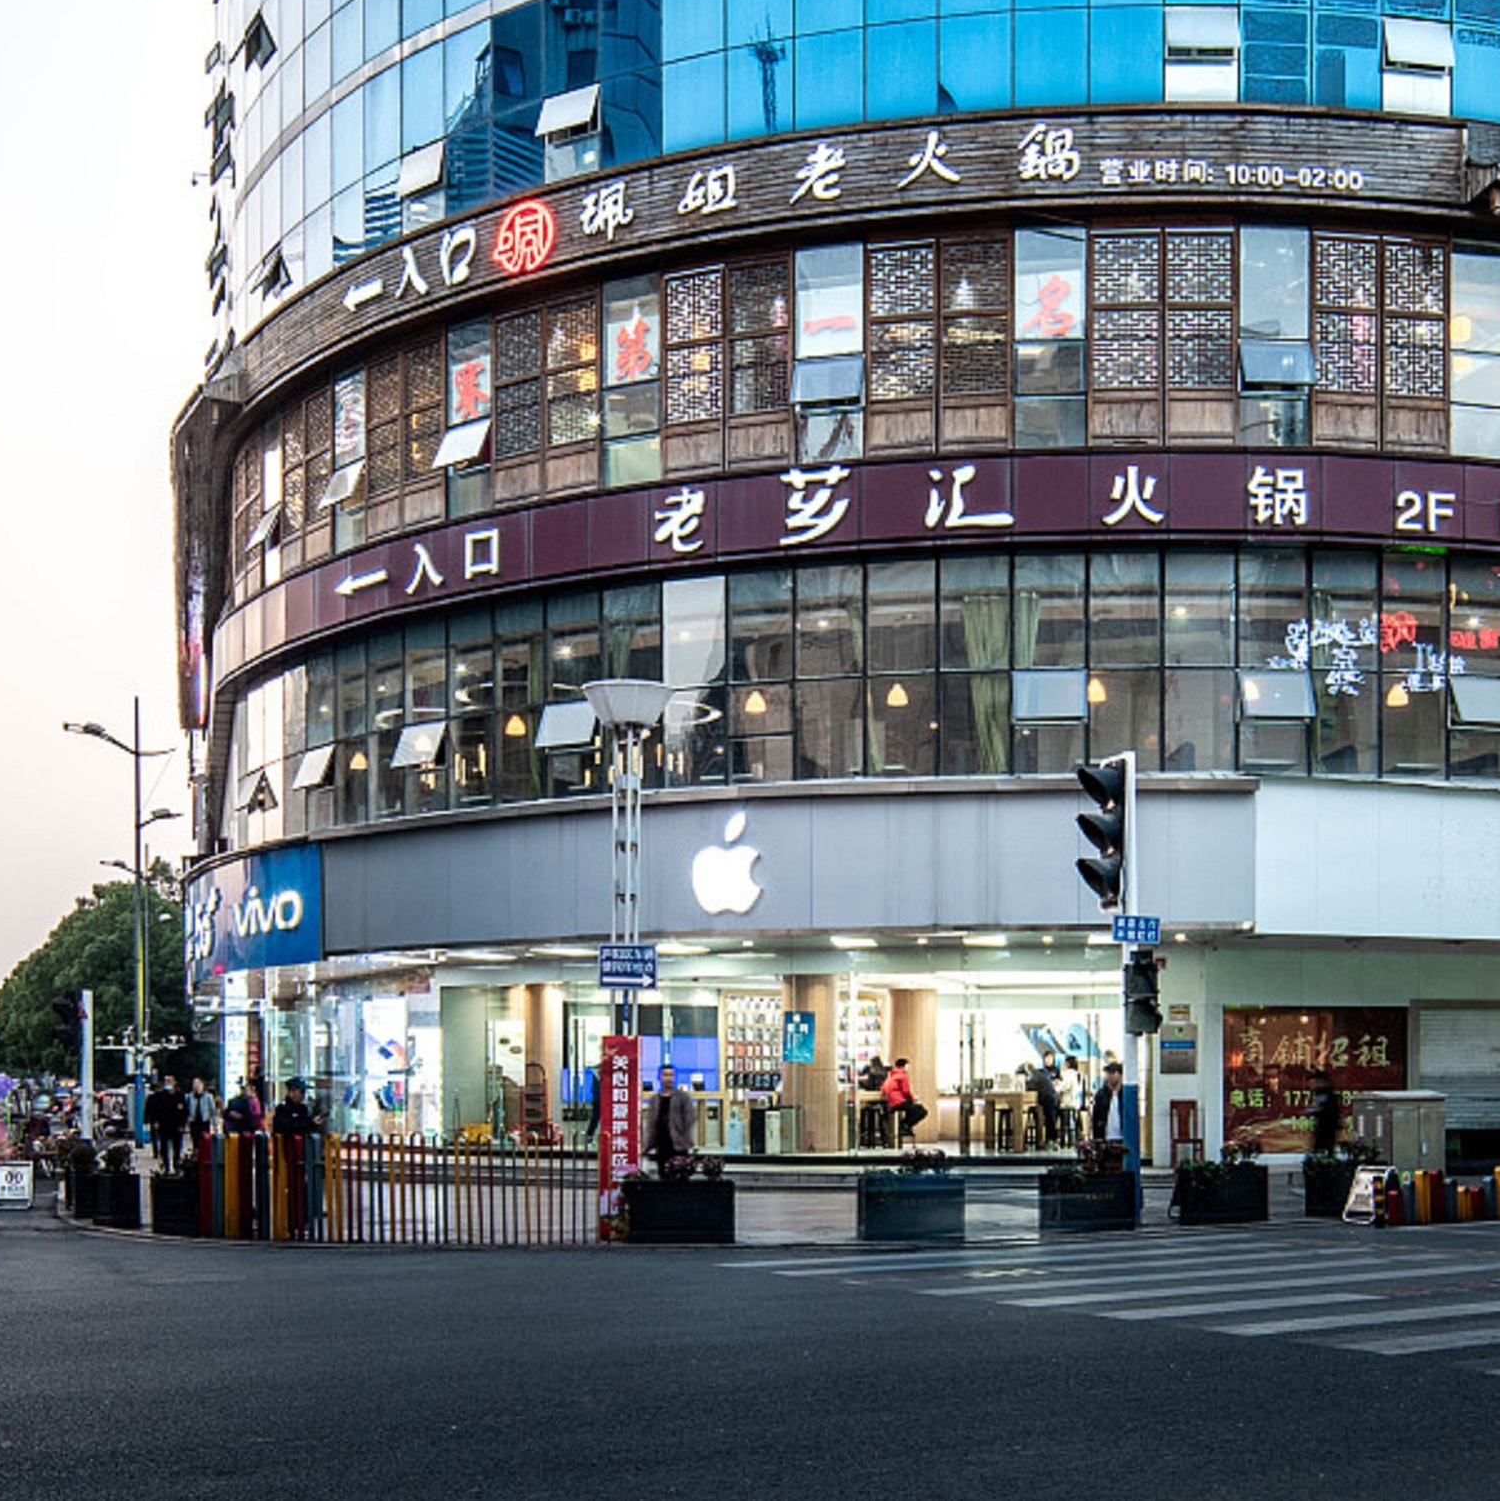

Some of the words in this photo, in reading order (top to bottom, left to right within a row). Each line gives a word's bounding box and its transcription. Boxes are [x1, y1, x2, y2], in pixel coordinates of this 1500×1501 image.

[1225, 165, 1364, 189] 10:00-02:00
[394, 226, 476, 298] 入口
[1396, 490, 1457, 532] 2F
[406, 528, 499, 594] 入口
[232, 886, 304, 938] vivo
[1240, 1026, 1391, 1076] 商铺招租
